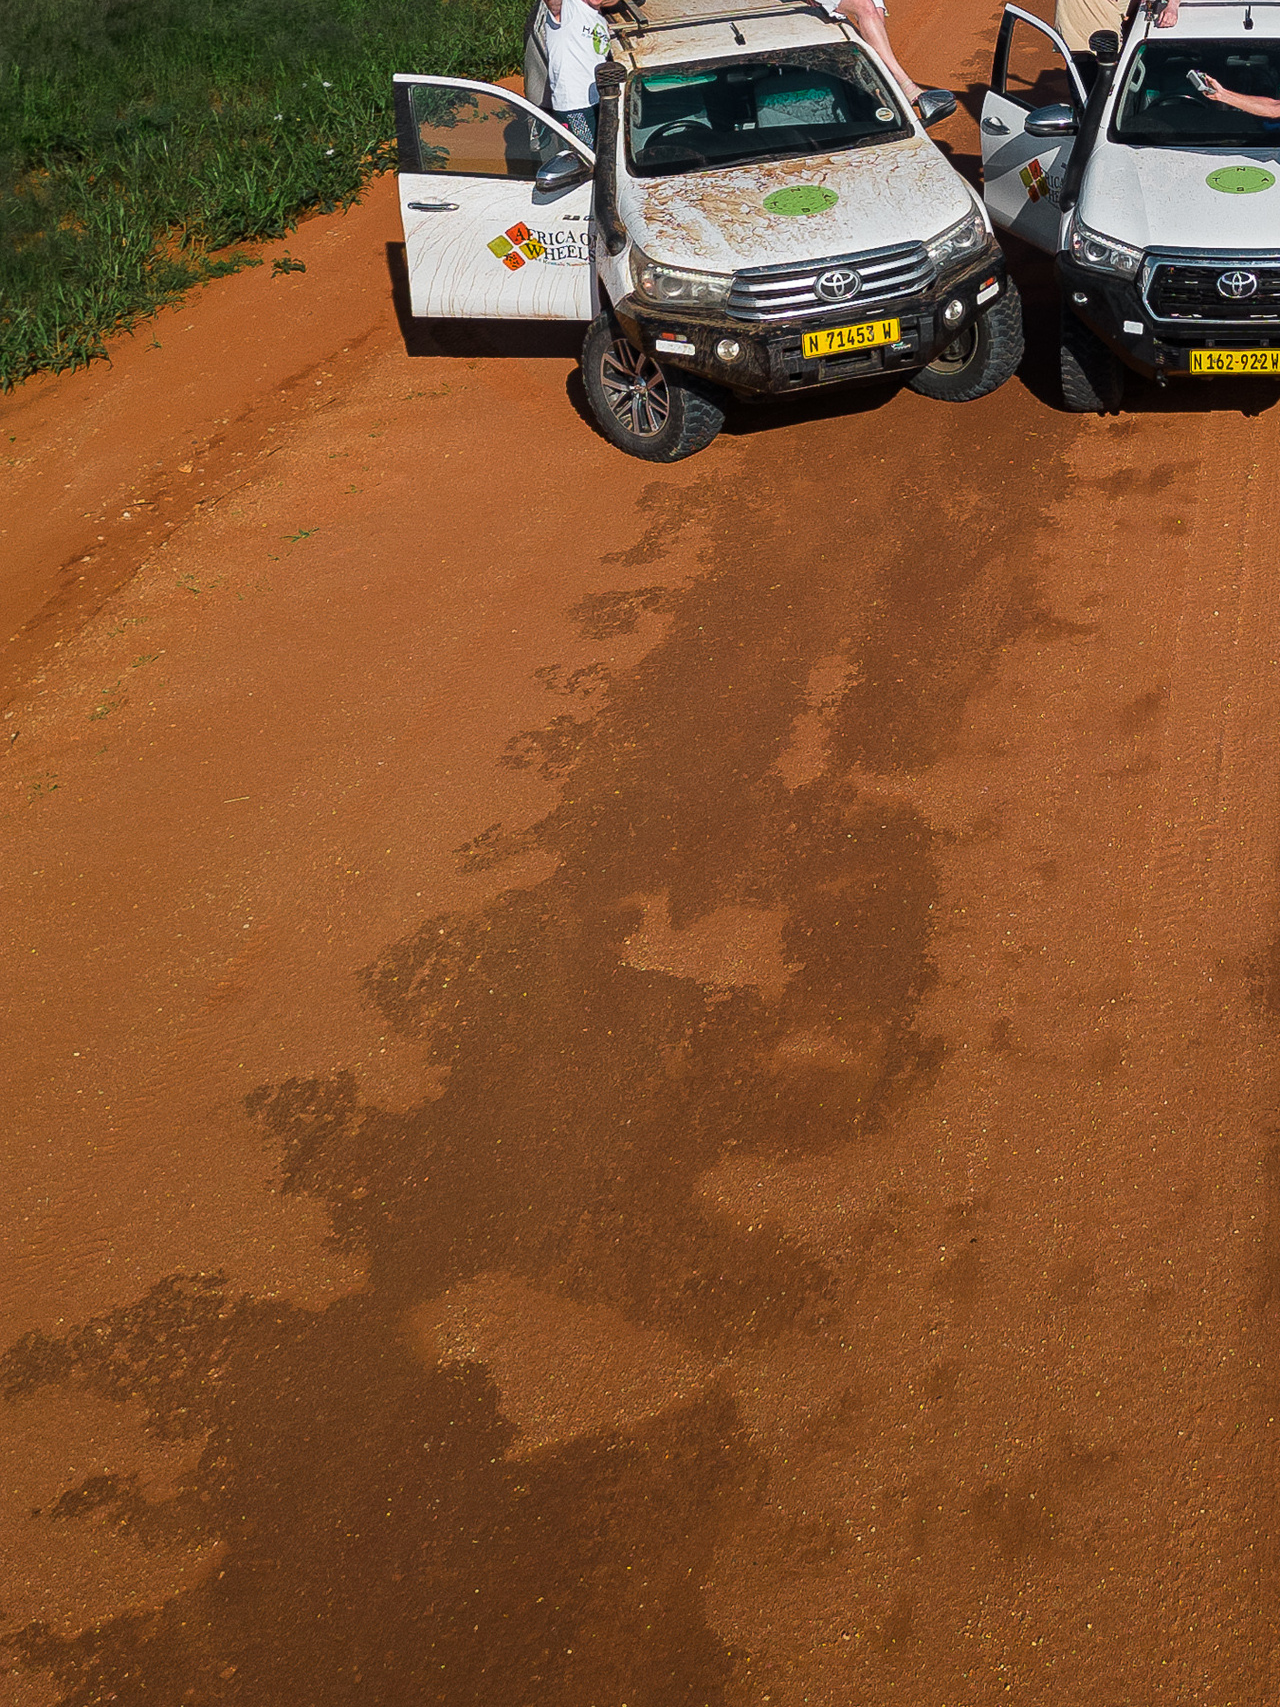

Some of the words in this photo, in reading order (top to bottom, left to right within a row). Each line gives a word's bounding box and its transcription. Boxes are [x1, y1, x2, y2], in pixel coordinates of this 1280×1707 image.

[514, 227, 577, 245] AFRICA
[525, 243, 596, 263] WHEELS
[809, 335, 819, 353] N
[827, 325, 875, 349] 71453
[882, 322, 891, 340] W
[1193, 354, 1202, 370] N
[1206, 353, 1268, 370] 162-922
[1271, 353, 1279, 370] W
